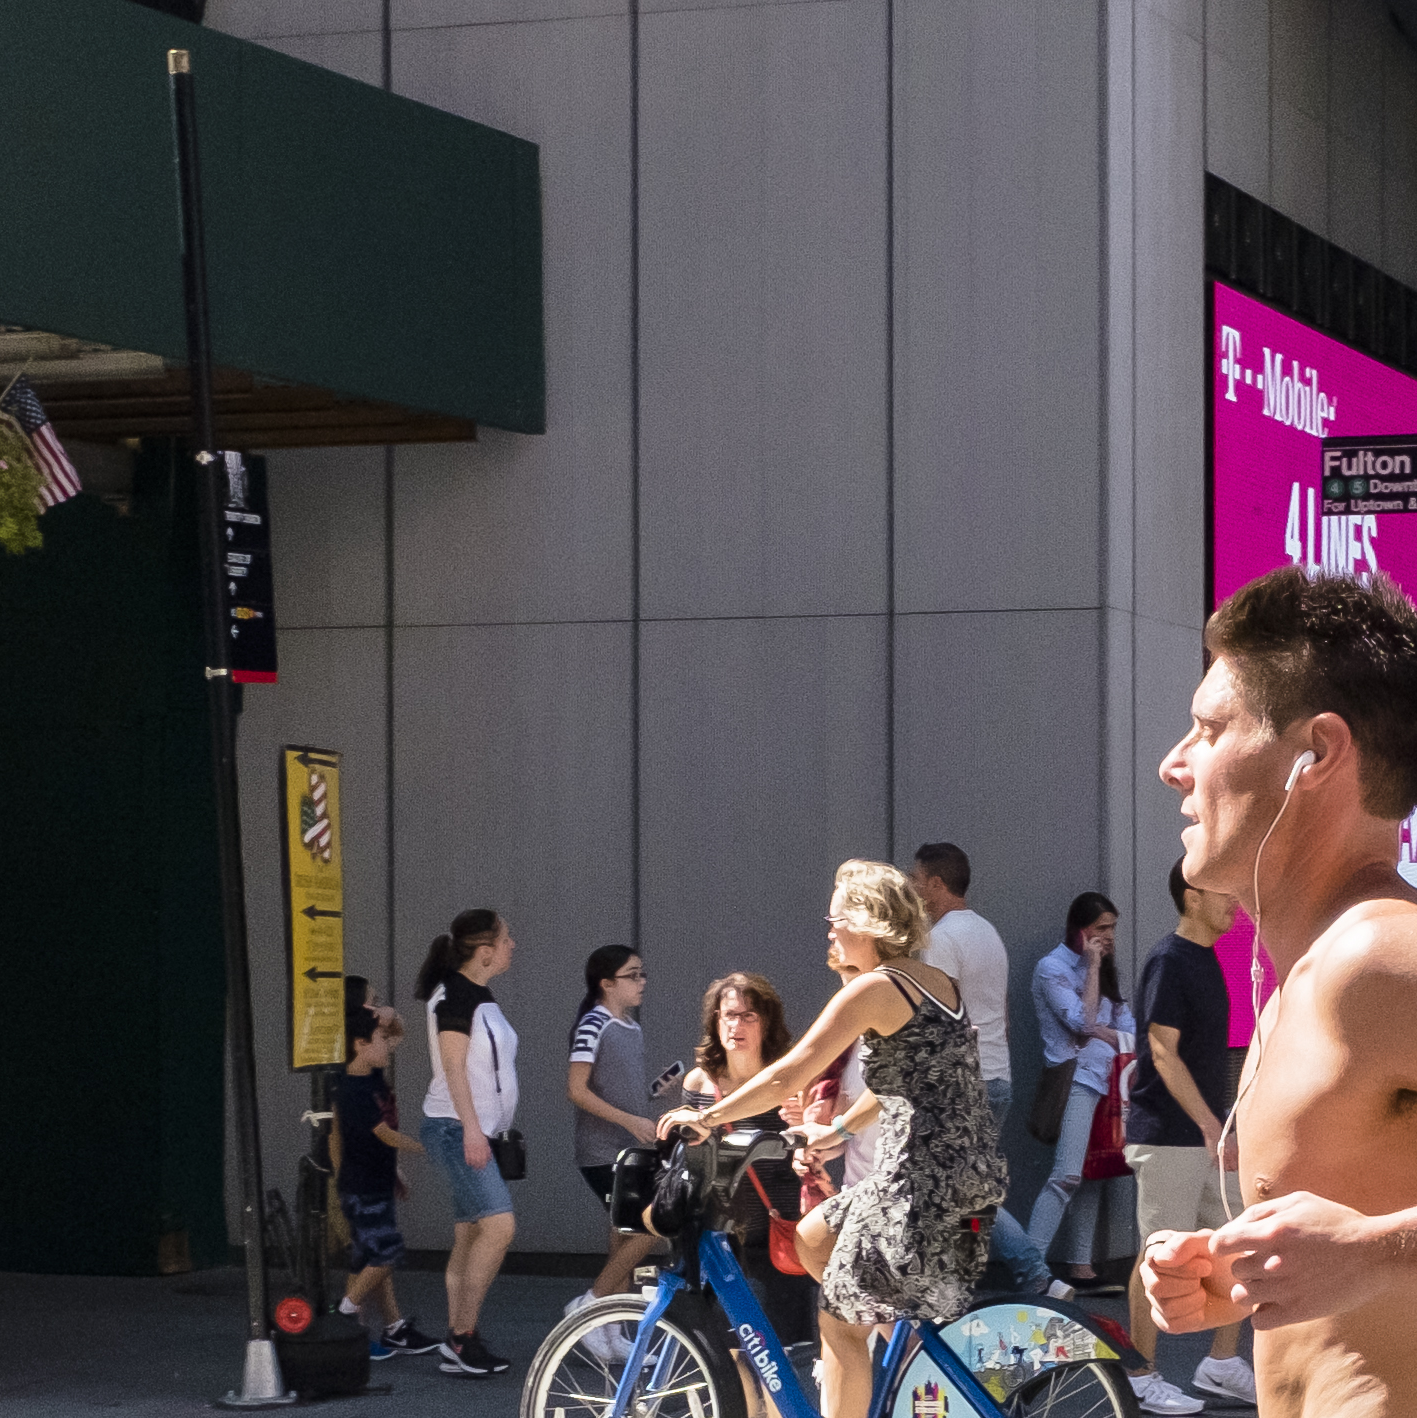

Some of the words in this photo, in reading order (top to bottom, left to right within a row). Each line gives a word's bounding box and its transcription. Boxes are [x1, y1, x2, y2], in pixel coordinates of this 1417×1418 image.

[1323, 451, 1411, 476] Fulton
[1323, 500, 1346, 512] For
[1350, 499, 1403, 513] Uptown
[1408, 498, 1417, 510] &
[1285, 482, 1302, 564] 4
[1307, 487, 1378, 578] LINES
